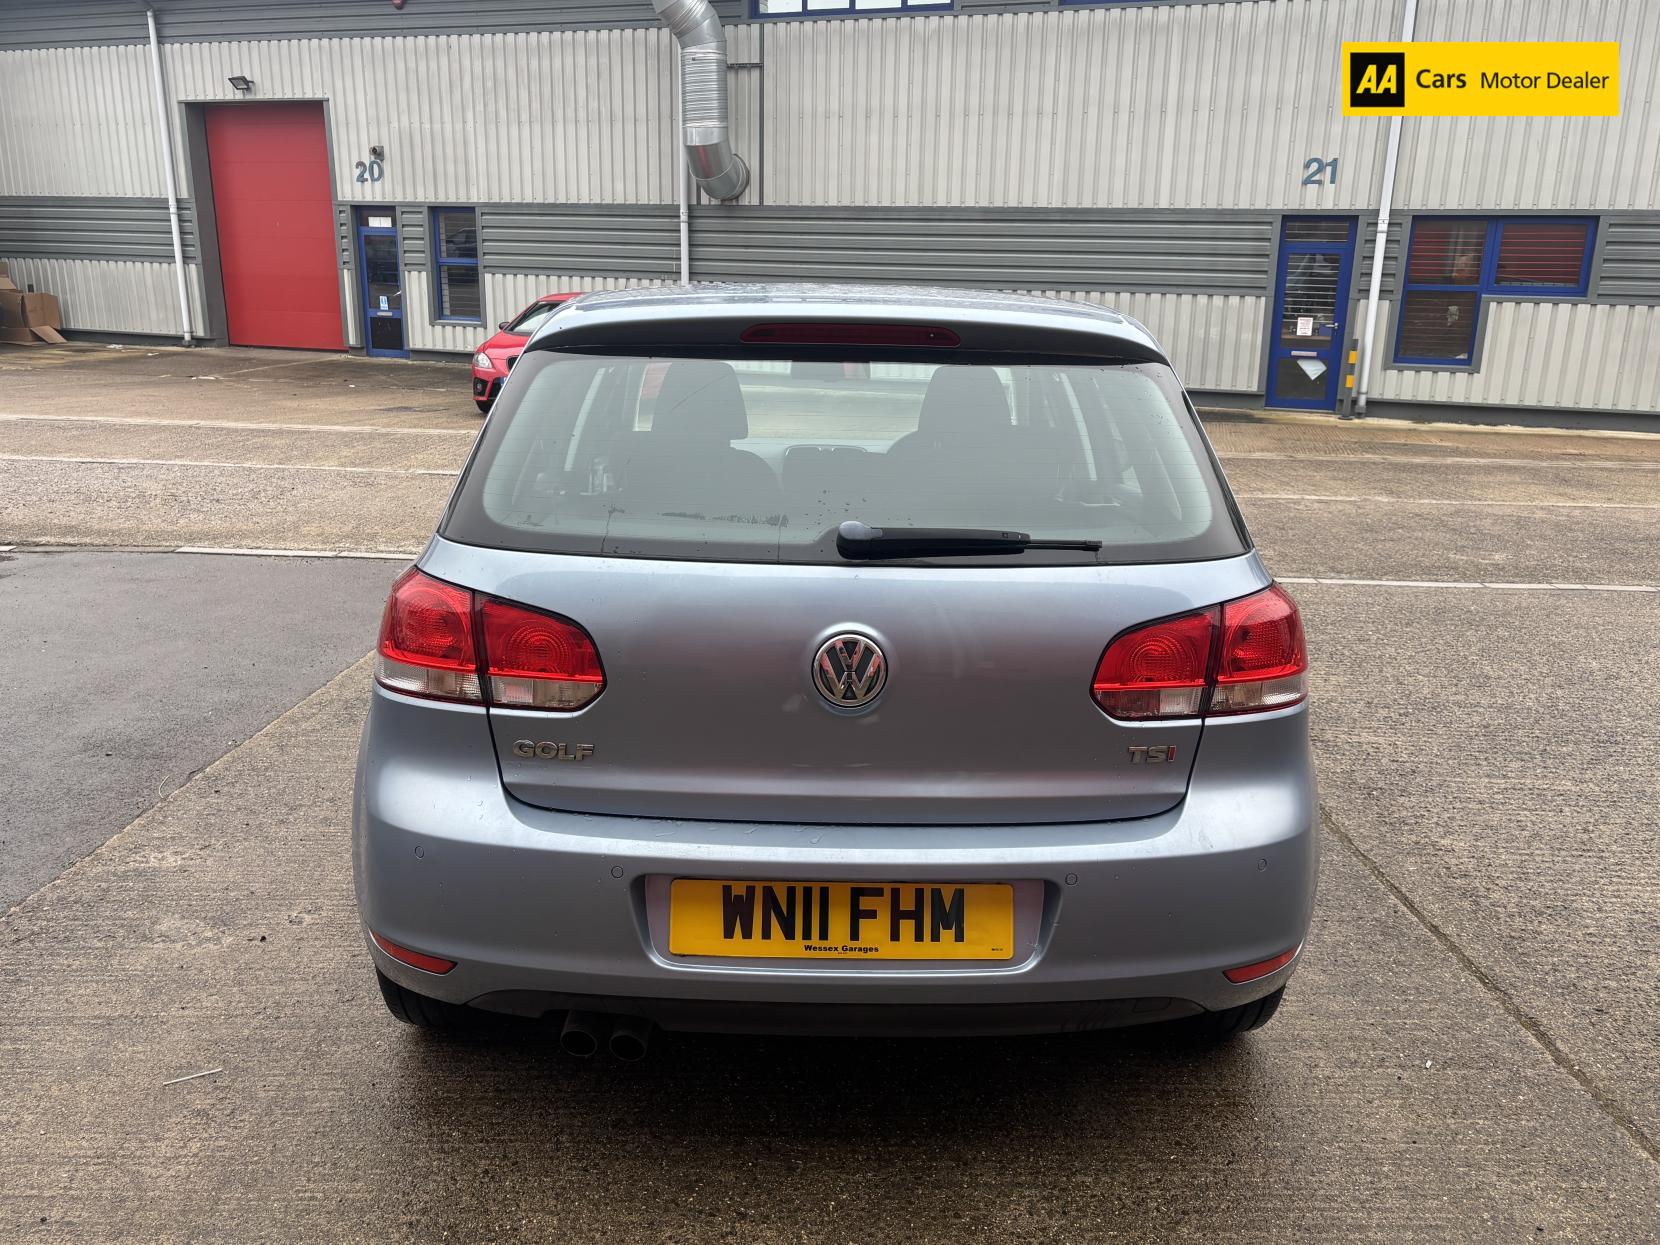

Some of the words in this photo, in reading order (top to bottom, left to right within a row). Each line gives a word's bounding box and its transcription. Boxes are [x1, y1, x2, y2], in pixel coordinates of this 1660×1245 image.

[355, 160, 384, 182] 20
[1303, 157, 1339, 185] 21
[512, 739, 595, 761] GOLF
[722, 884, 829, 941] WN11
[850, 886, 965, 943] FHM
[804, 944, 839, 952] Wessex
[841, 945, 879, 954] Garages
